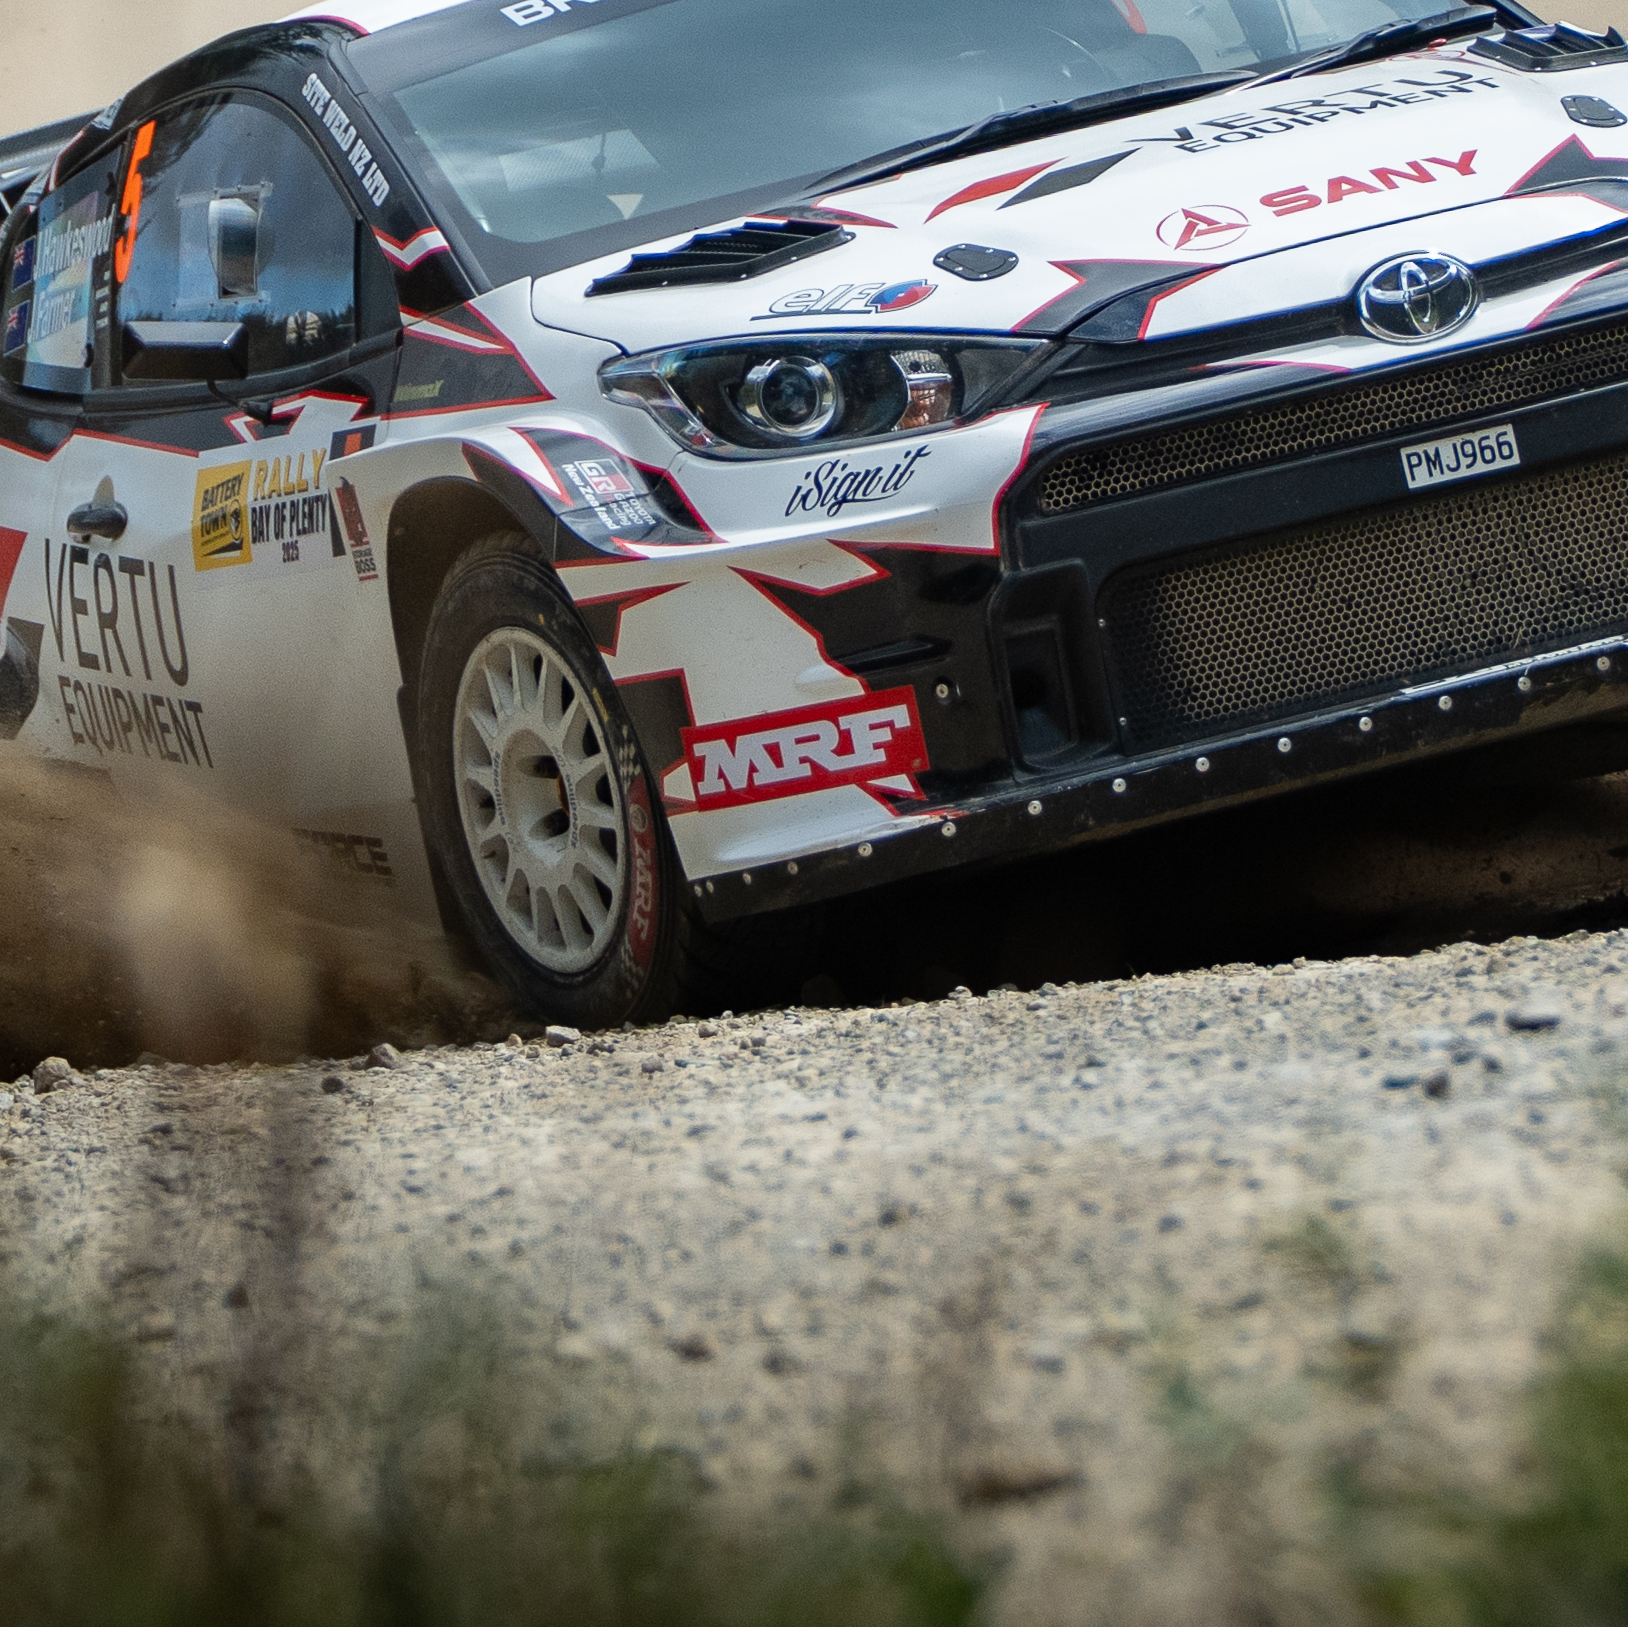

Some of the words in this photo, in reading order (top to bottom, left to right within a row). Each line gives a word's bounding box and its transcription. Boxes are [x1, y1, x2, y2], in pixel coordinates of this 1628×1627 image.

[1121, 70, 1473, 144] VERTU
[1173, 77, 1500, 153] EQUIPMENT
[301, 72, 332, 116] SITE
[323, 99, 357, 152] WELD
[348, 138, 372, 177] NZ
[361, 161, 390, 207] LTD
[114, 120, 156, 284] 5
[1259, 149, 1478, 217] SANY
[769, 283, 886, 315] elf
[253, 448, 327, 501] RALLY
[580, 462, 617, 491] GR
[1405, 431, 1514, 482] PMJ966
[200, 504, 228, 537] TOWN
[201, 473, 244, 513] BATTERY
[251, 504, 271, 544] BAY
[273, 501, 287, 539] OF
[289, 493, 327, 537] PLENTY
[562, 464, 584, 486] New
[579, 485, 621, 529] Zealand
[614, 493, 644, 524] GAZOO
[625, 492, 656, 525] TOYOTA
[45, 538, 189, 687] VERTU
[58, 675, 214, 768] EQUIPMENT
[693, 704, 911, 795] MRF
